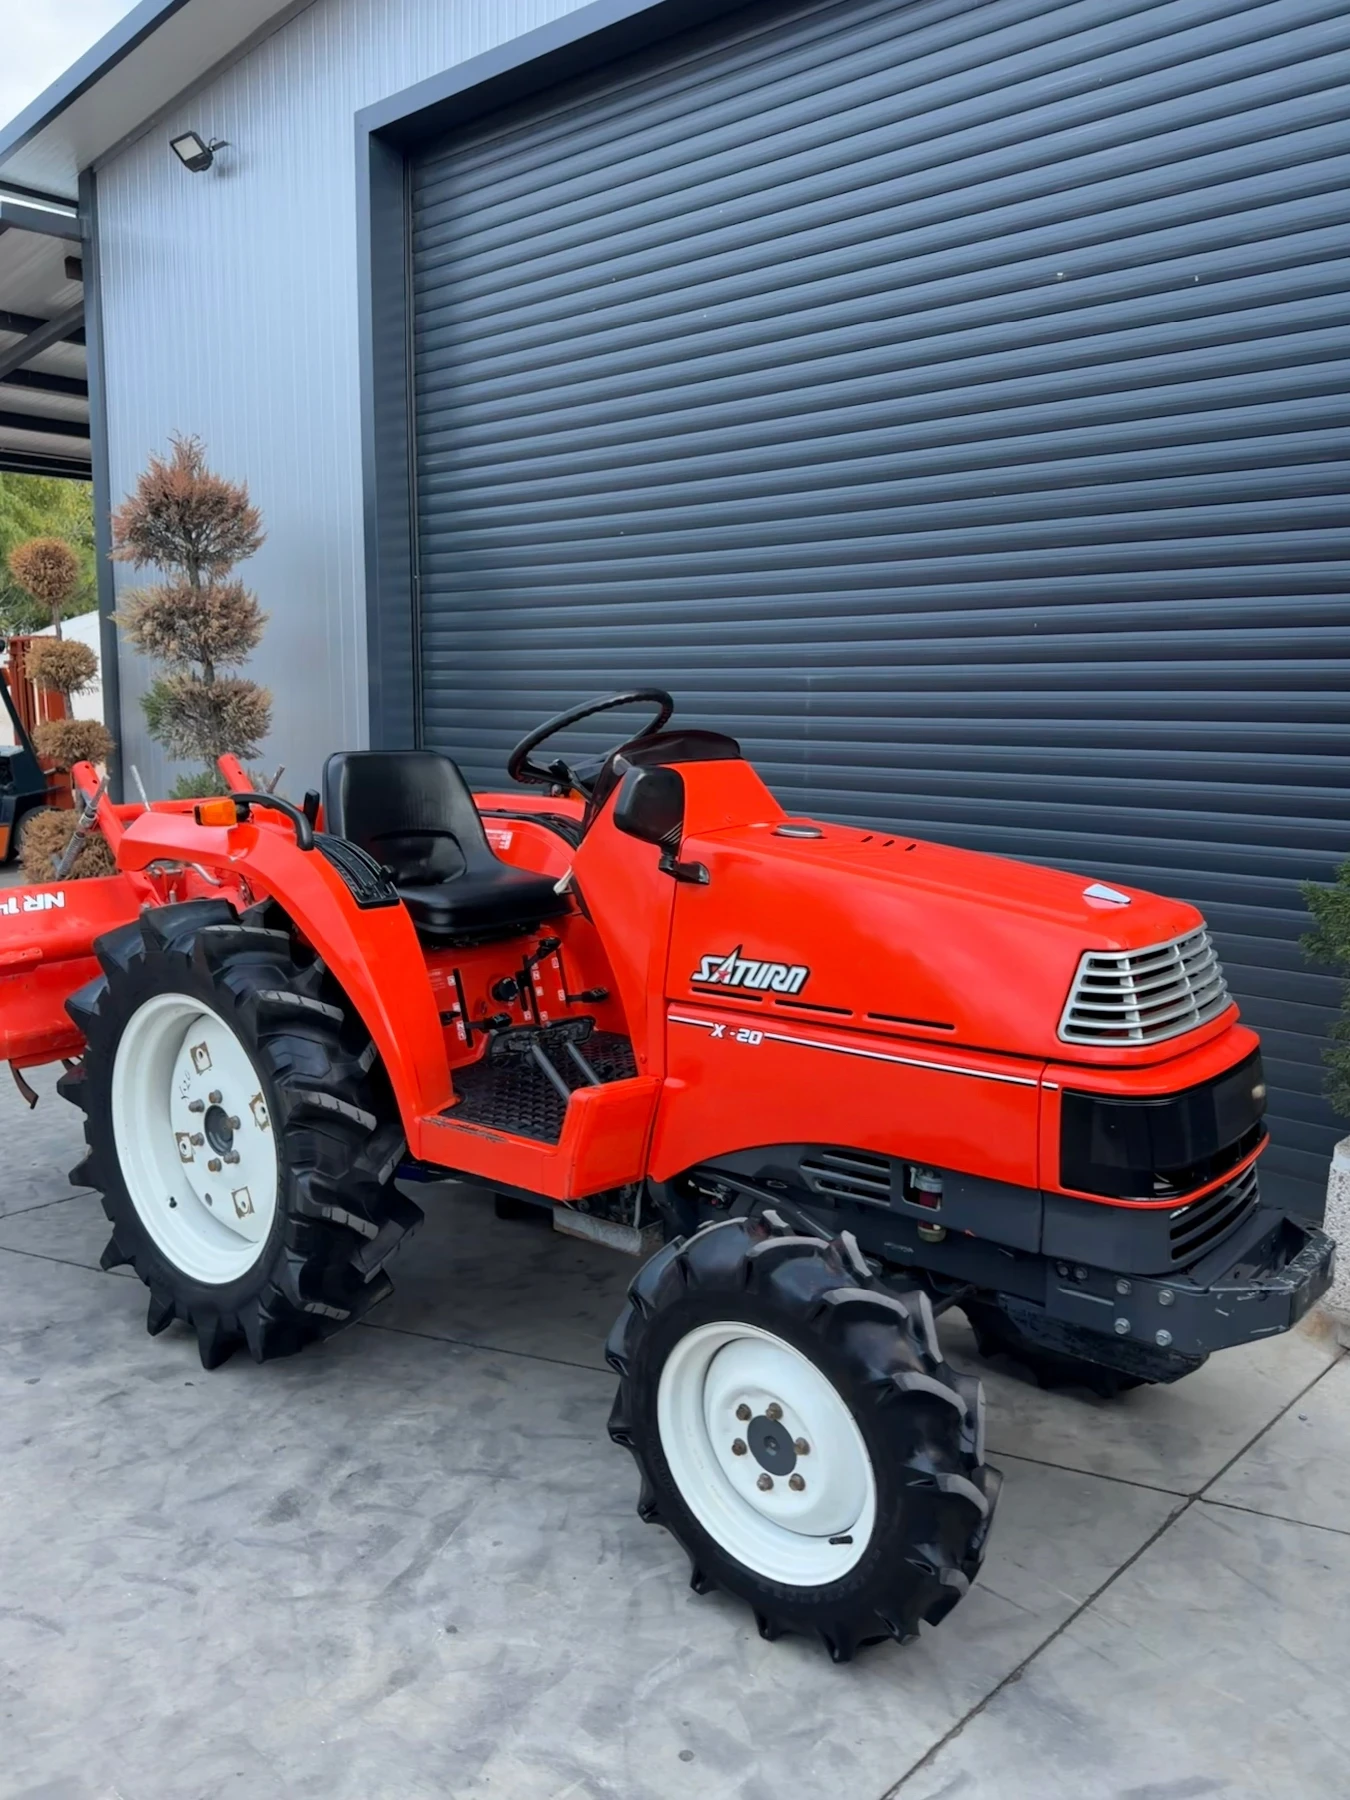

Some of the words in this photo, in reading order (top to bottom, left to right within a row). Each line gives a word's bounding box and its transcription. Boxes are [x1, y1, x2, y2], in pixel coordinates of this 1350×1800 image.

[23, 891, 65, 912] NR
[690, 944, 810, 995] SATURN
[710, 1023, 763, 1045] X-20
